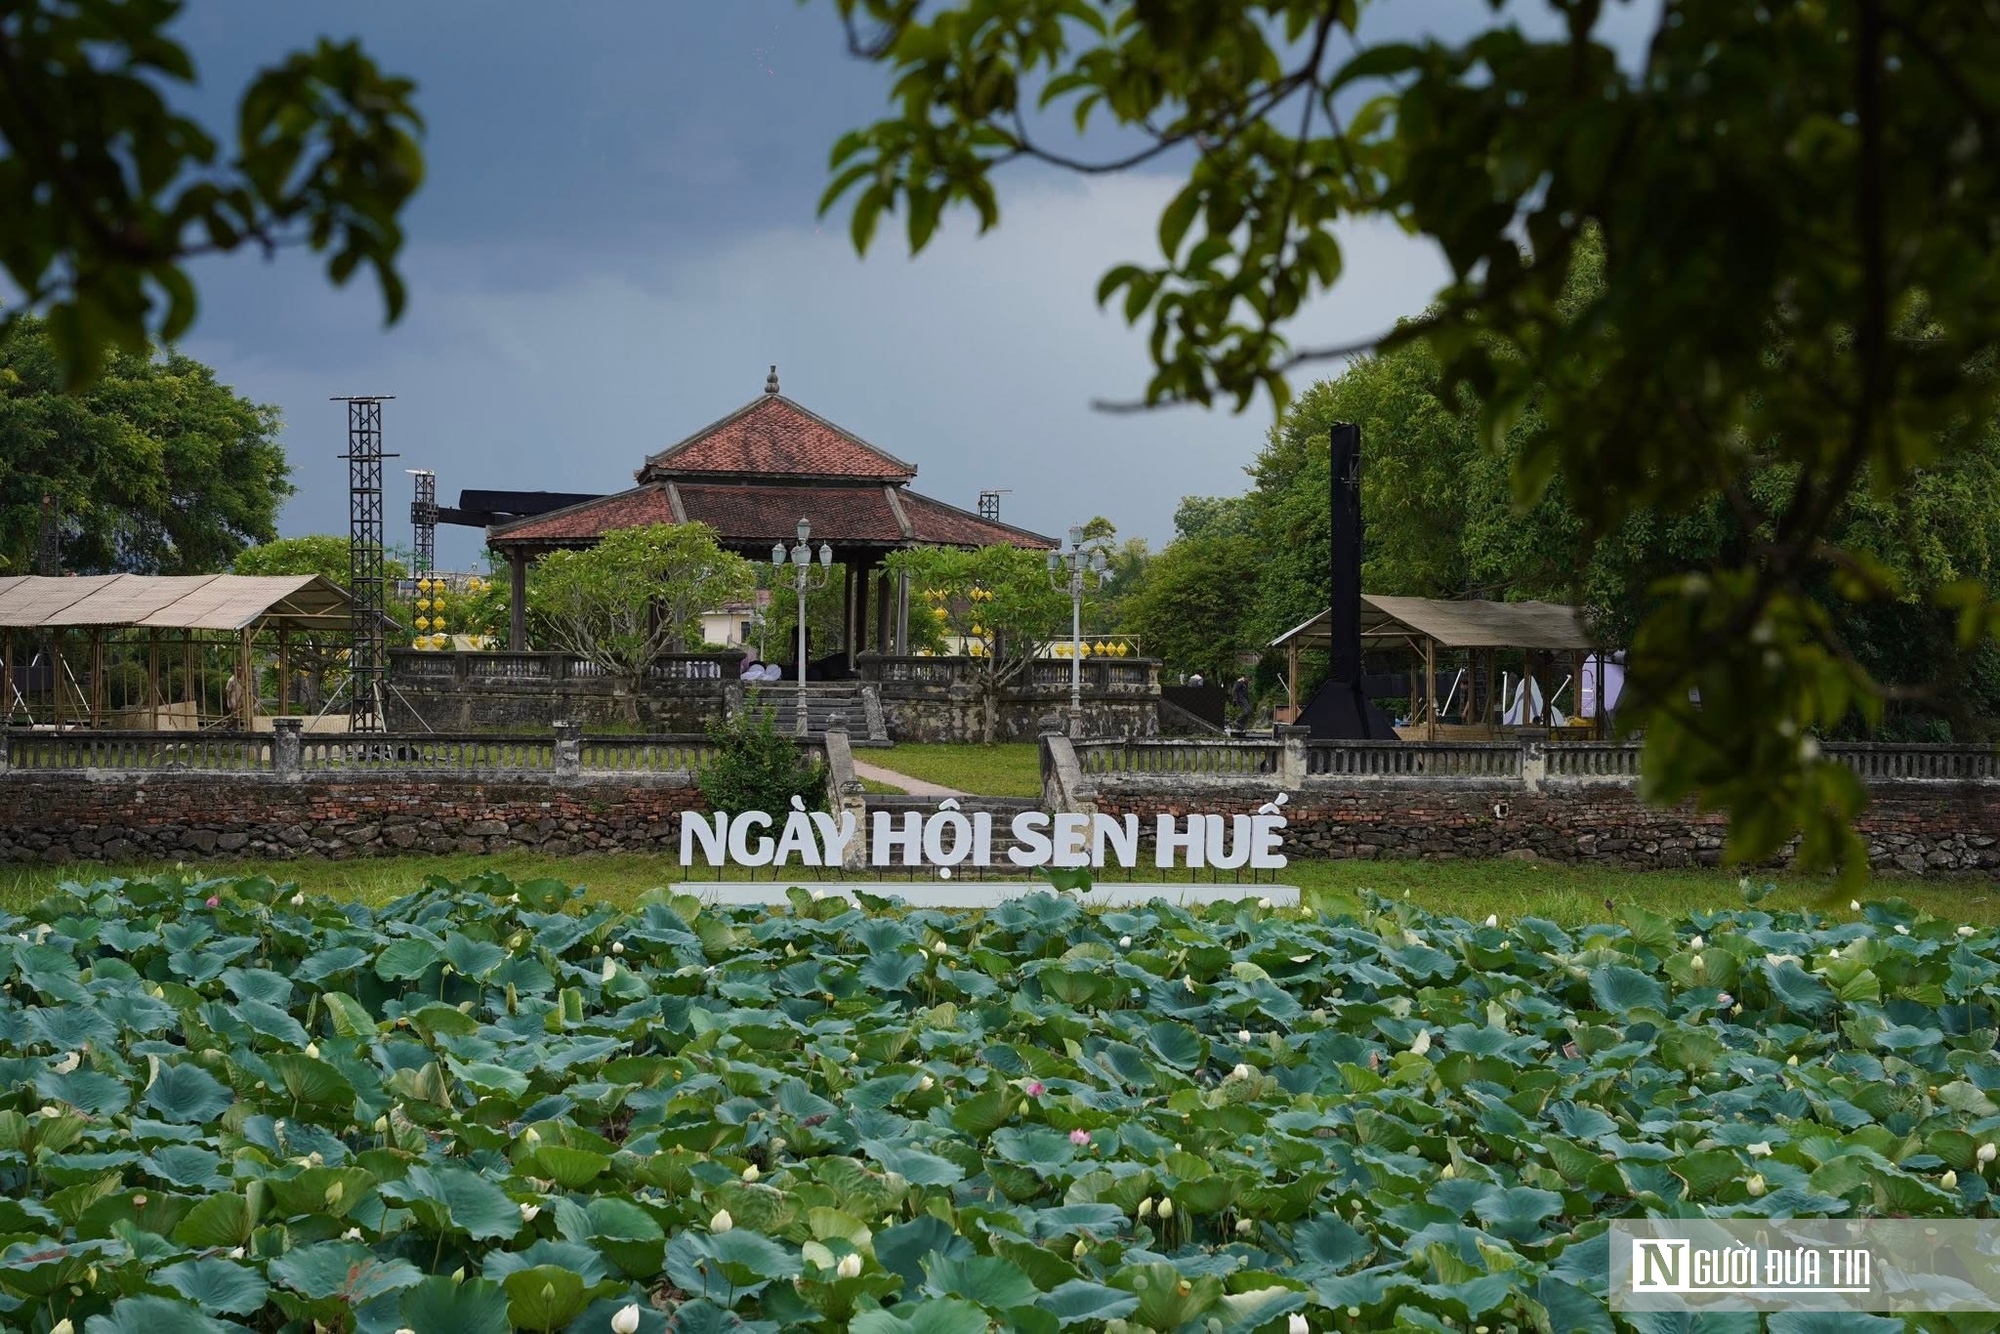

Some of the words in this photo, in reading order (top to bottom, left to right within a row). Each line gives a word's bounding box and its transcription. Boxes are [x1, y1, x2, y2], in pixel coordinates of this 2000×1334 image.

[680, 795, 855, 867] NGÀY
[873, 798, 992, 880] HỘI
[1009, 811, 1139, 868] SEN
[1156, 792, 1288, 869] HUẾ
